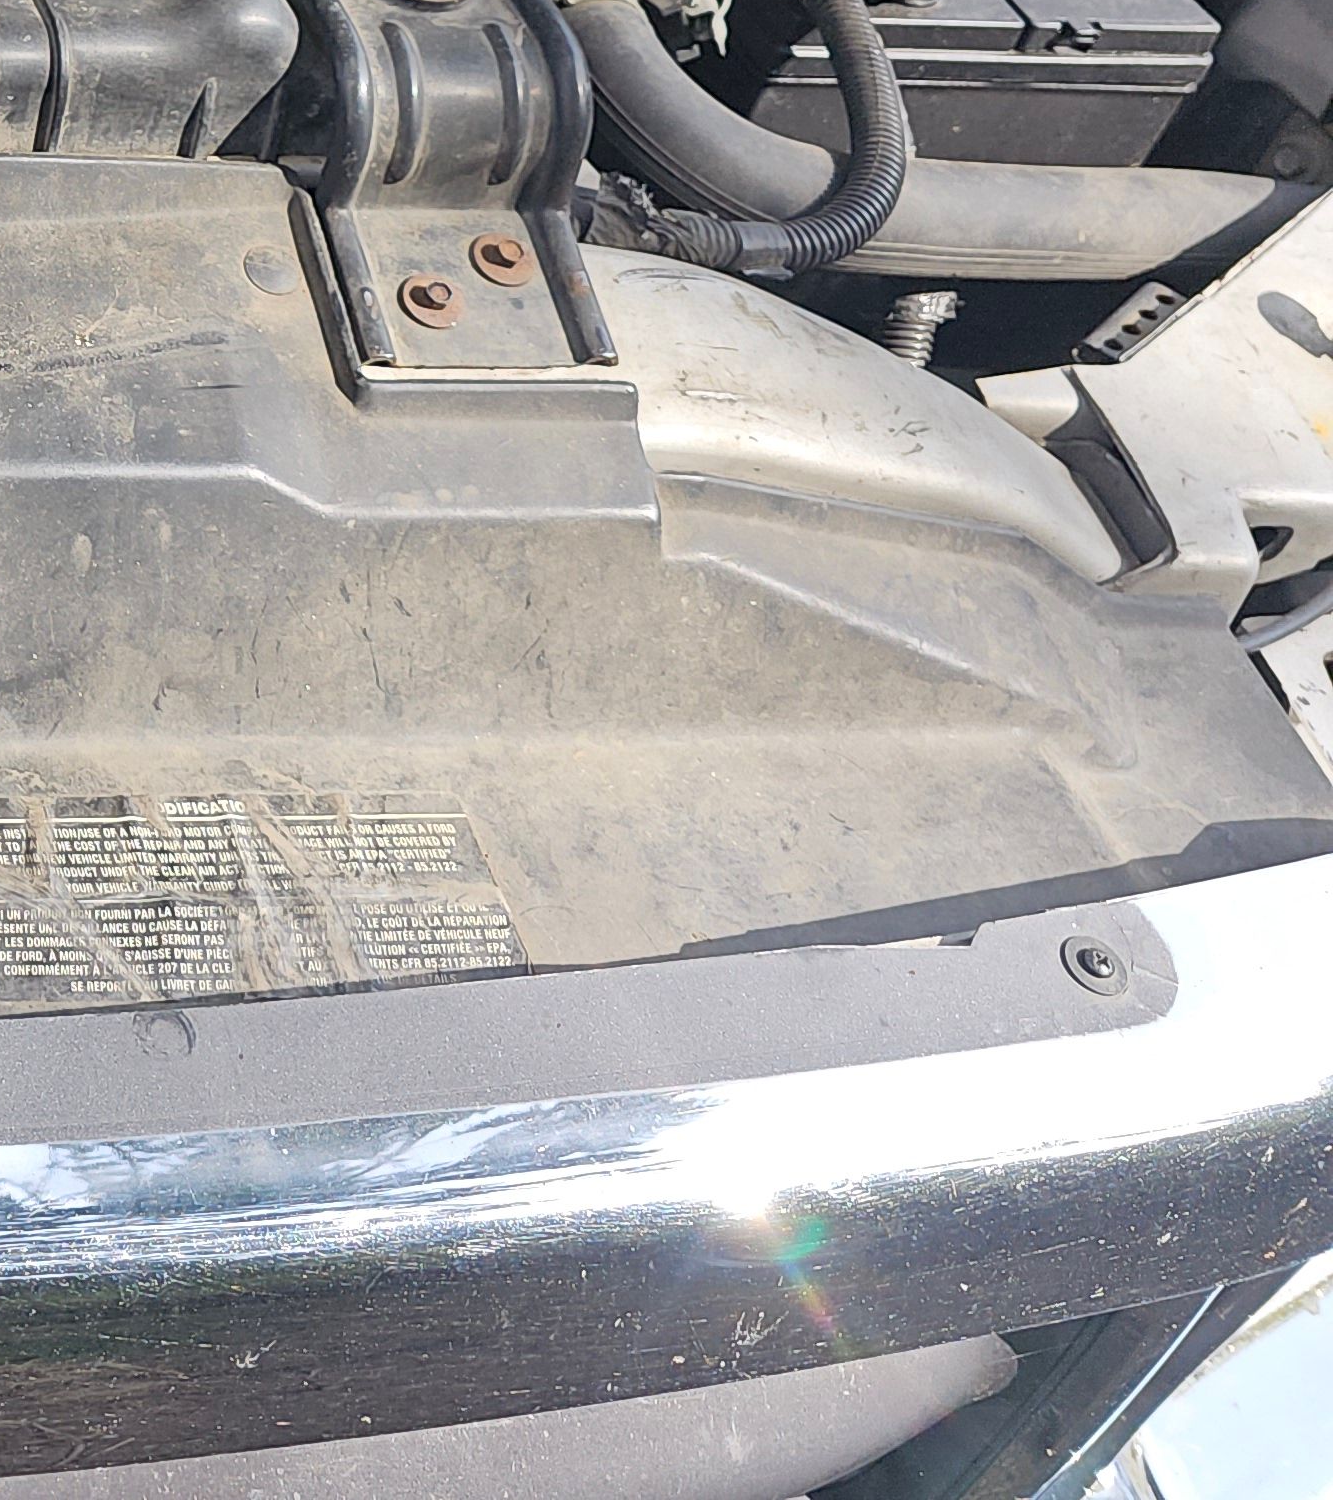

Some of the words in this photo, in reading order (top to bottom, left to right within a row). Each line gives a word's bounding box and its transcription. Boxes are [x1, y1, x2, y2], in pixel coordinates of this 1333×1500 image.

[160, 799, 246, 816] DIFICATIO
[102, 827, 117, 839] OF
[183, 826, 222, 838] MOTOR
[289, 824, 324, 836] ODUCT
[358, 823, 374, 835] OR
[375, 823, 417, 835] CAUSES
[426, 822, 456, 835] FORD
[4, 841, 21, 852] TO
[73, 840, 101, 852] COST
[102, 840, 117, 851] OF
[120, 839, 141, 851] THE
[143, 839, 181, 850] REPAIR
[182, 838, 205, 850] AND
[207, 838, 228, 850] ANY
[324, 837, 352, 849] WILL
[353, 837, 374, 849] NOT
[375, 836, 390, 848] BE
[390, 836, 441, 848] COVERED
[442, 835, 457, 847] BY
[68, 853, 112, 865] VEHICLE
[113, 853, 156, 864] LIMITED
[156, 852, 217, 864] WARRANTY
[349, 849, 363, 860] AN
[365, 849, 387, 861] EPA
[100, 866, 137, 878] UNDER
[139, 866, 159, 877] THE
[161, 865, 197, 877] CLEAN
[198, 865, 217, 877] AIR
[413, 861, 458, 873] 85.2122
[65, 881, 94, 894] YOUR
[95, 880, 139, 893] VEHICLE
[203, 879, 236, 891] GUIDE
[6, 909, 21, 921] UN
[94, 908, 132, 920] FOURNI
[133, 907, 156, 920] PAR
[157, 907, 172, 918] LA
[366, 916, 379, 928] LE
[410, 915, 425, 927] DE
[427, 915, 441, 927] LA
[442, 912, 508, 927] RÉPARATION
[131, 922, 147, 934] OU
[148, 920, 183, 933] CAUSE
[184, 920, 199, 932] LA
[375, 927, 415, 942] LIMITÉE
[417, 929, 432, 941] DE
[434, 926, 482, 940] VÉHICULE
[484, 928, 512, 940] NEUF
[4, 936, 25, 948] LES
[144, 935, 159, 947] NE
[160, 933, 201, 946] SERONT
[203, 933, 225, 946] PAS
[421, 940, 473, 955] CERTIFIÉE
[0, 950, 14, 963] DE
[15, 949, 48, 963] FORD,
[58, 949, 95, 962] MOINS
[124, 948, 173, 962] S'AGISSE
[173, 947, 204, 961] D'UNE
[401, 956, 423, 969] CFR
[3, 961, 89, 977] CONFORMÉMENT
[157, 962, 178, 975] 207
[179, 962, 195, 974] DE
[195, 961, 210, 974] LA
[70, 981, 84, 993] SE
[160, 979, 197, 992] LIVRET
[198, 979, 214, 991] DE
